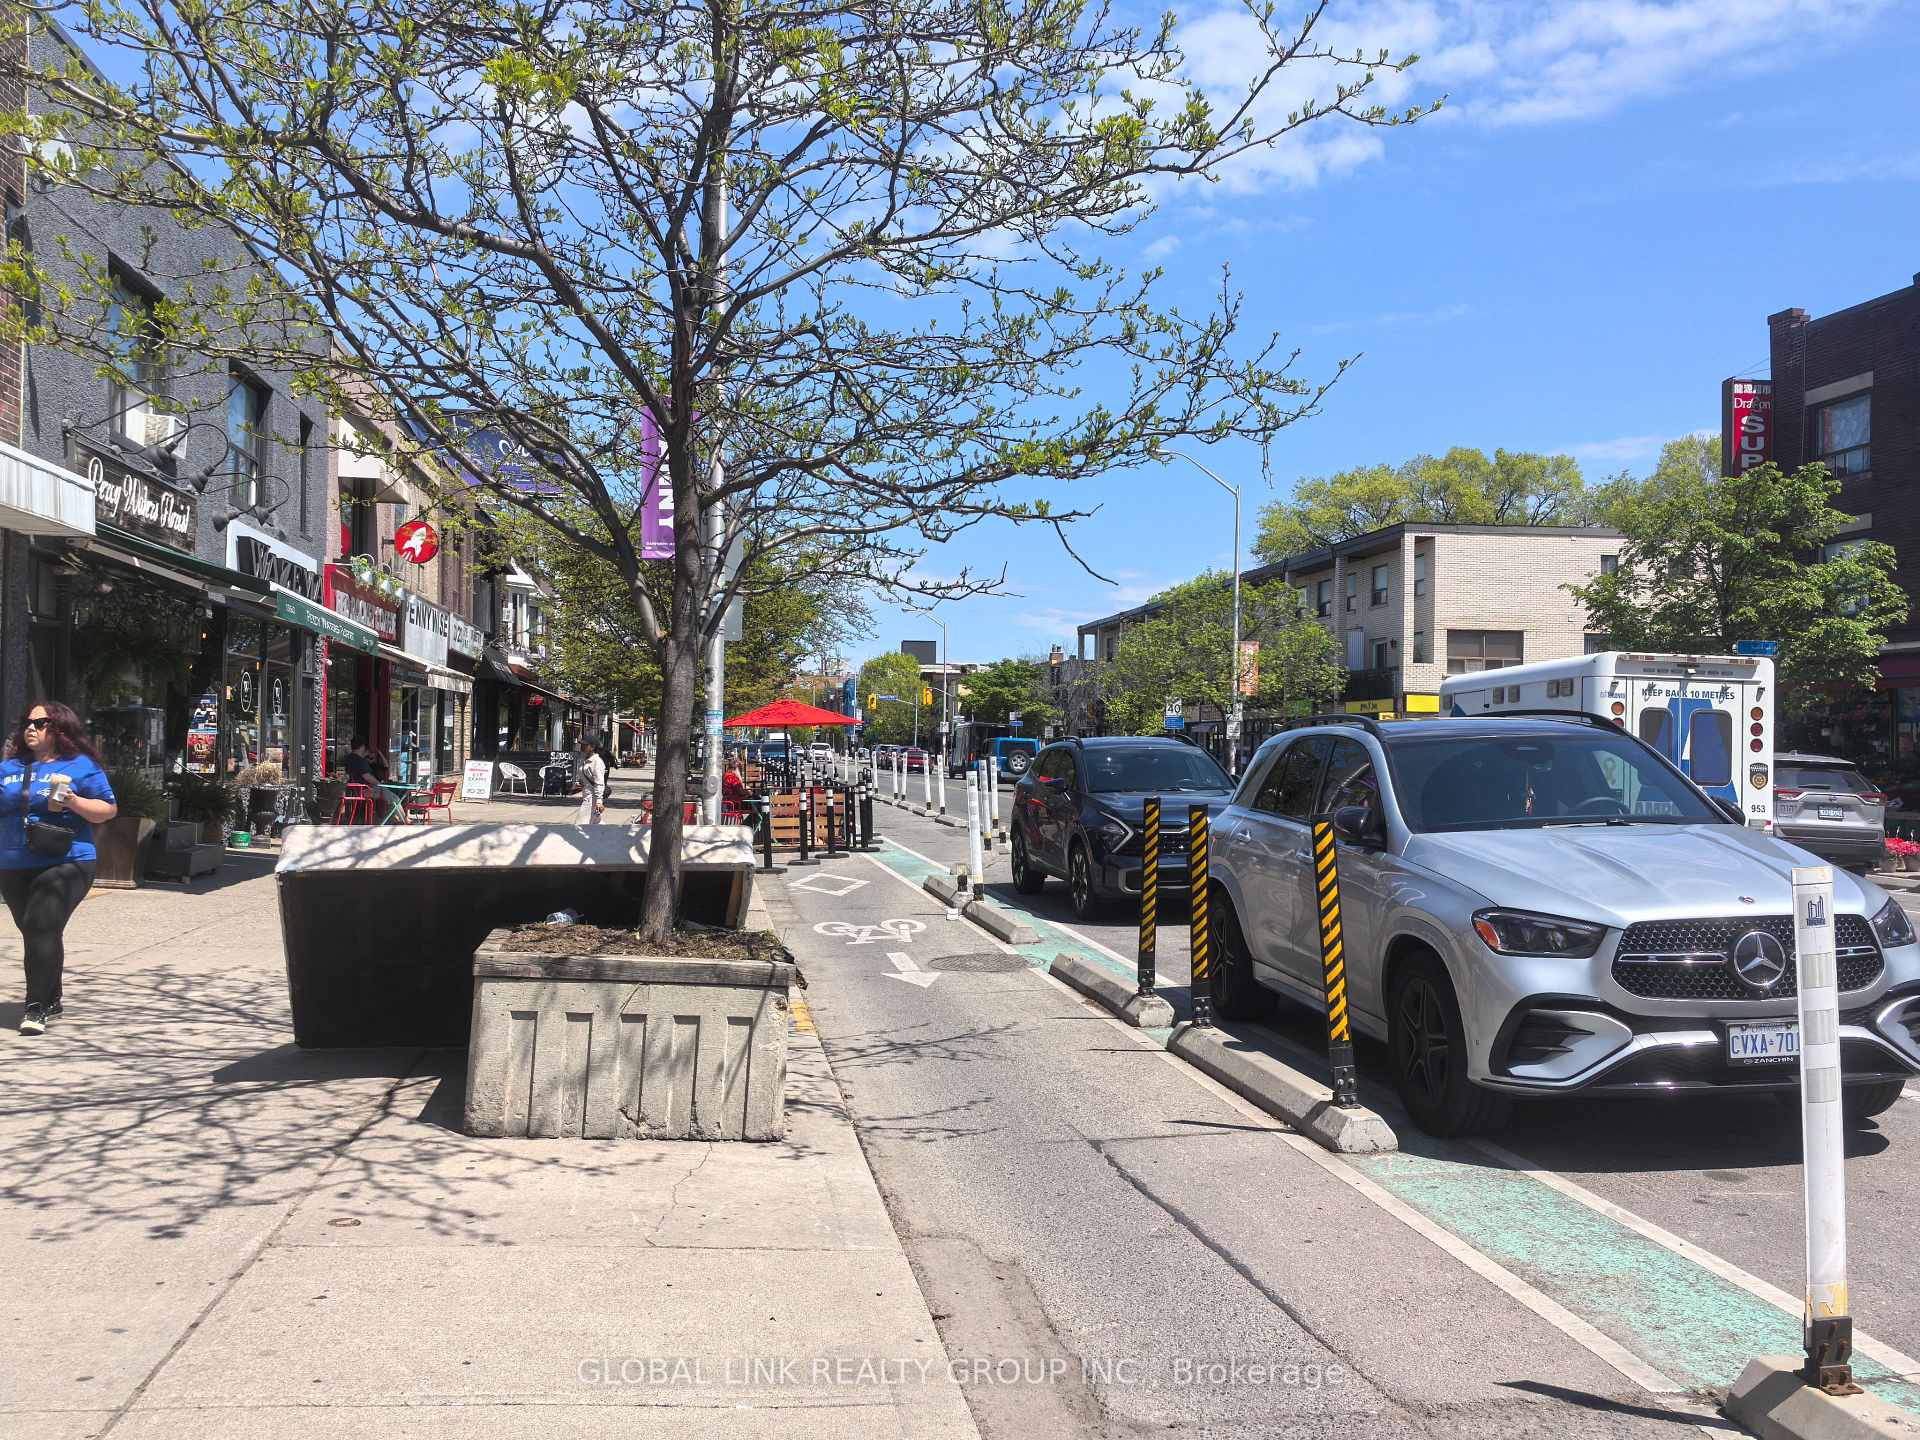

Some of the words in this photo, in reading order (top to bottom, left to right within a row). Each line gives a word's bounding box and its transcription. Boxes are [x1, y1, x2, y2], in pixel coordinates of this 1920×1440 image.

[88, 456, 122, 518] Percy
[160, 491, 190, 534] Florist
[1641, 688, 1663, 698] KEEP
[1665, 689, 1688, 699] BACK
[1691, 690, 1700, 699] 10
[1167, 703, 1181, 714] 40
[1751, 804, 1766, 813] 953
[1731, 1034, 1768, 1054] CVXA
